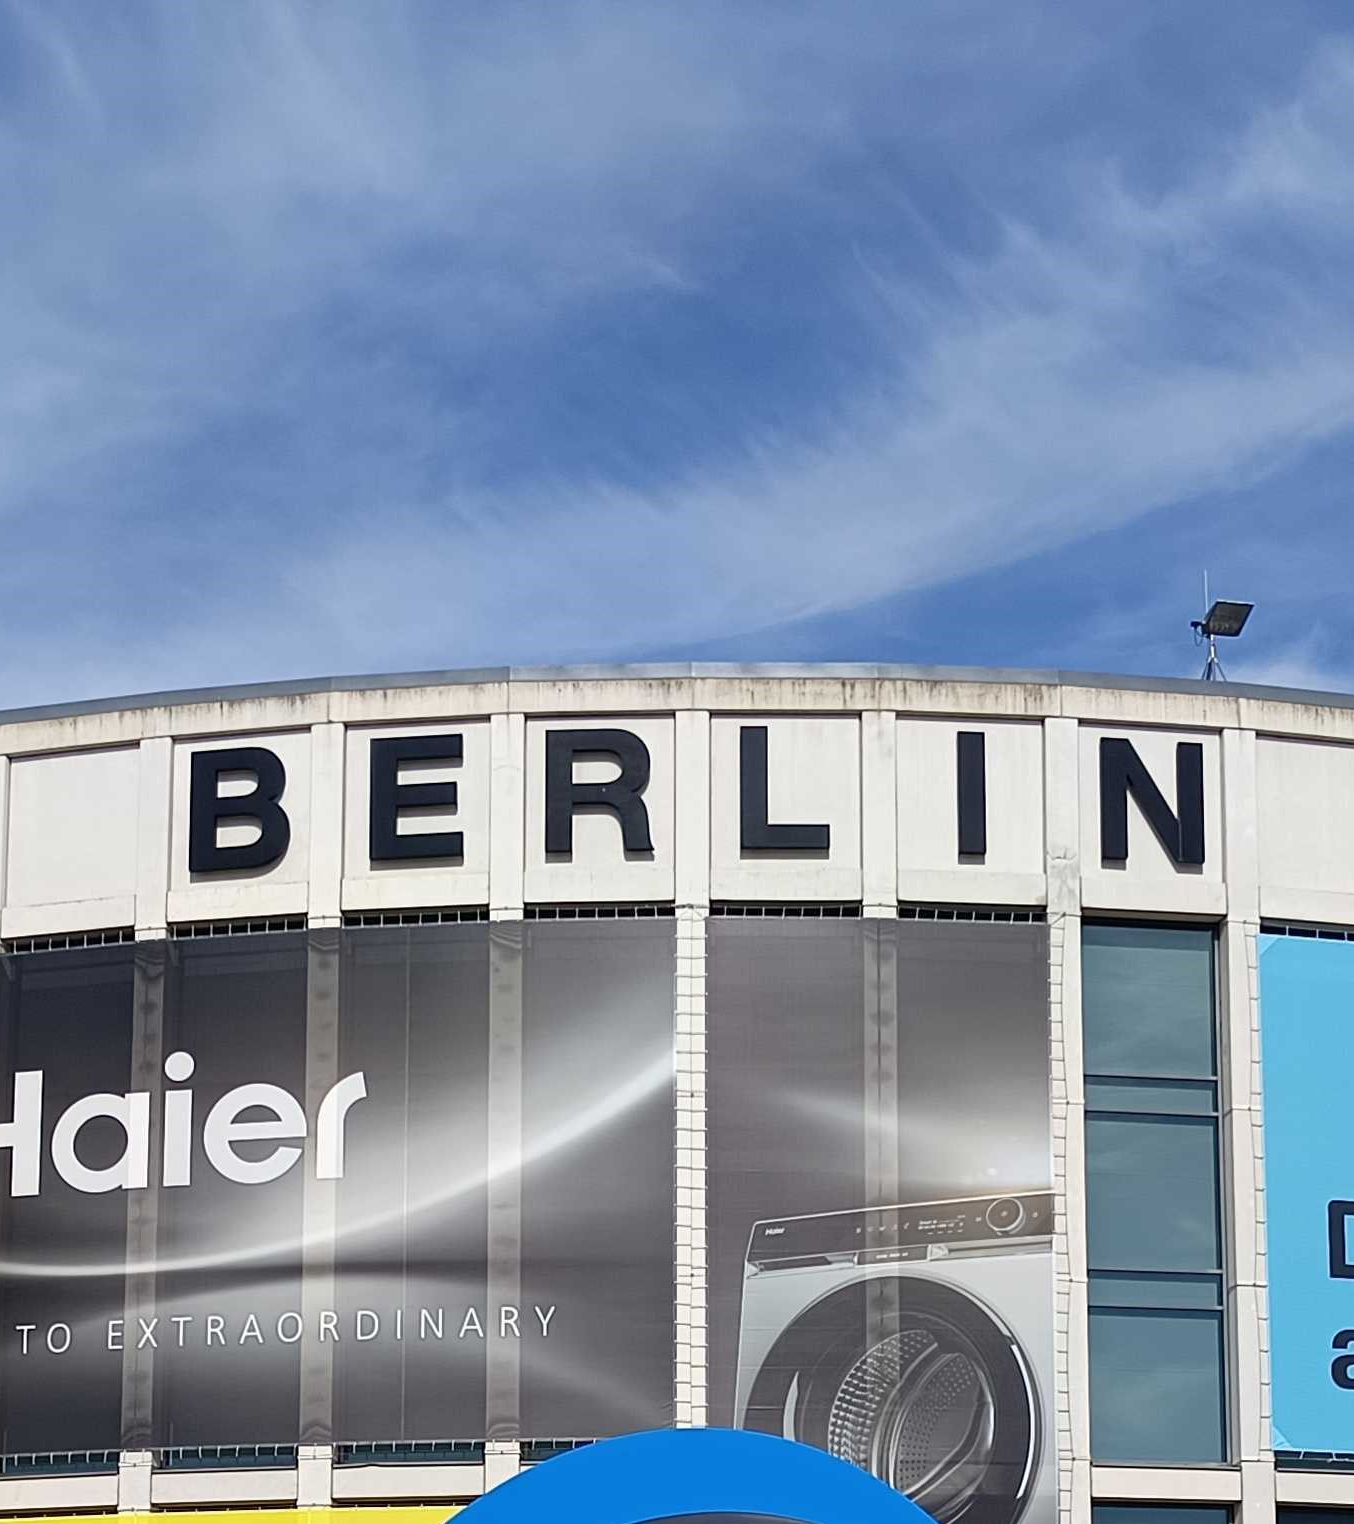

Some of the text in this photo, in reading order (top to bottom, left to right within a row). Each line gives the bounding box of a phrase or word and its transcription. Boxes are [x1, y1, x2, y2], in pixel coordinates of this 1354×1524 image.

[188, 725, 1206, 873] BERLIN
[16, 1323, 73, 1357] TO
[106, 1305, 559, 1352] EXTRAORDINARY
